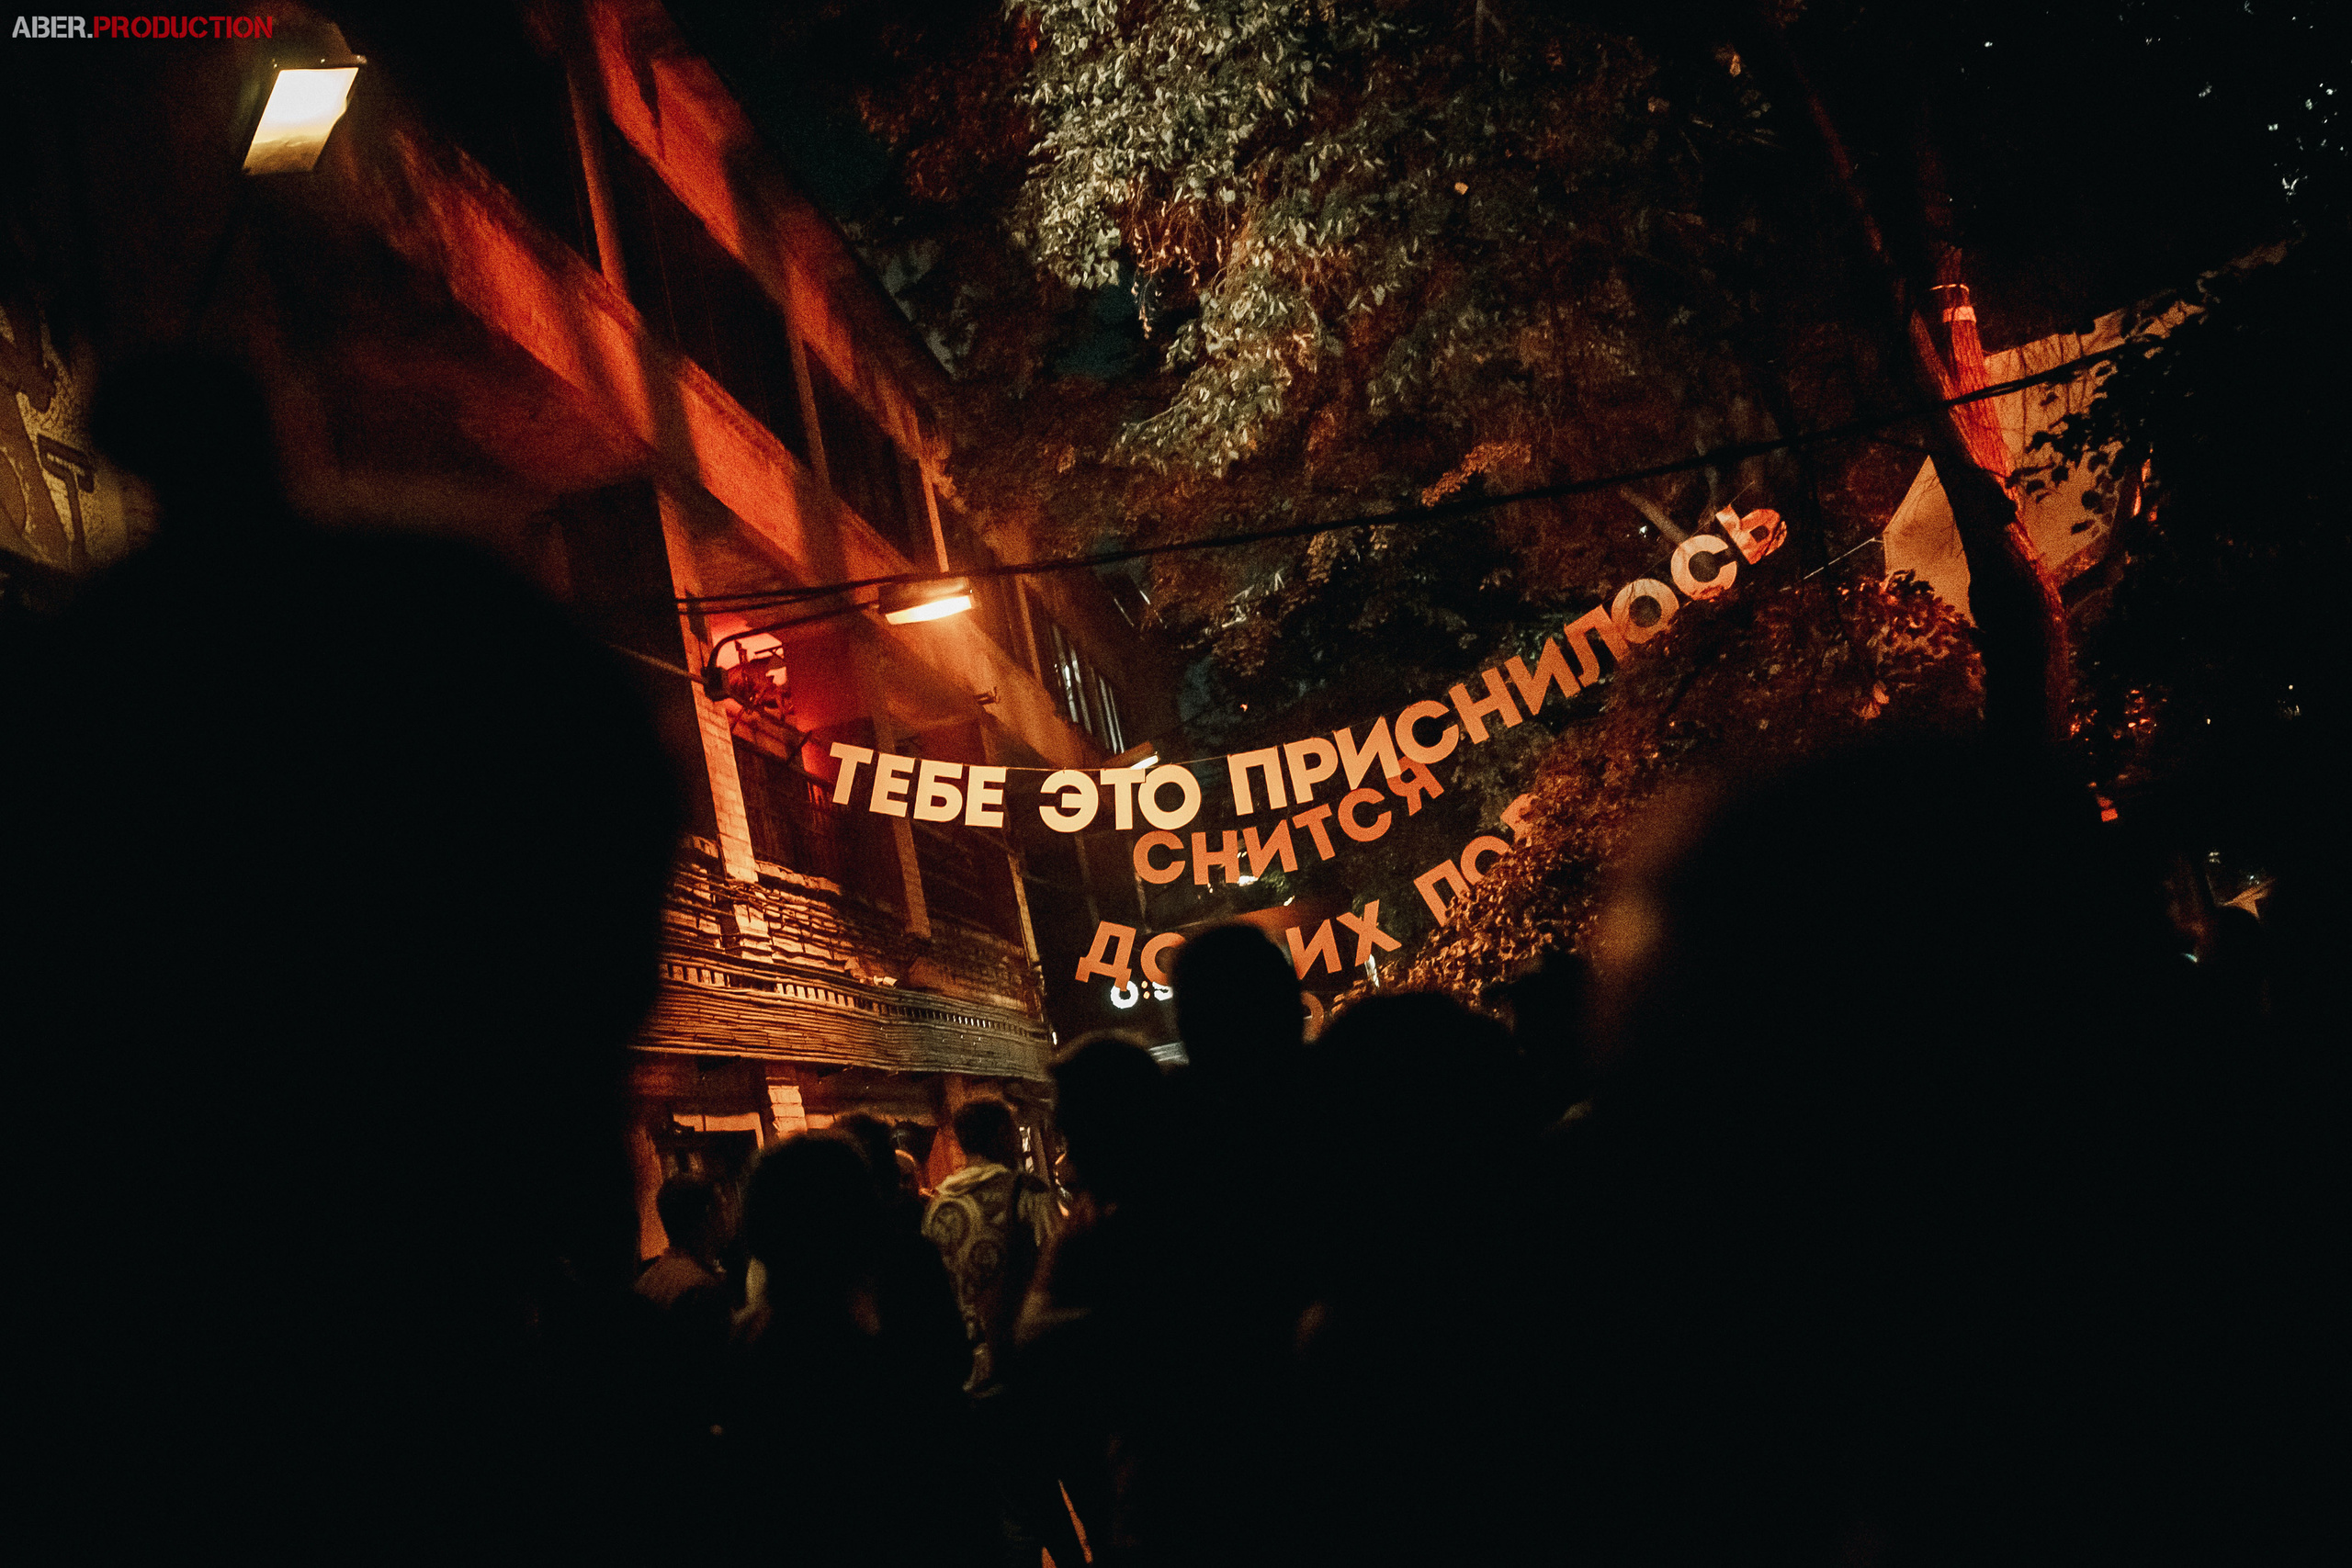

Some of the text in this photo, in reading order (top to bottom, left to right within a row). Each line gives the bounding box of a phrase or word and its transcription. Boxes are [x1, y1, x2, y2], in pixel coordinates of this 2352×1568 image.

[830, 504, 1788, 833] ТЕБЕ ЭТО ПРИСНИЛОСЬ
[1133, 757, 1444, 885] СНИТСЯ
[1284, 899, 1402, 981] ИХ
